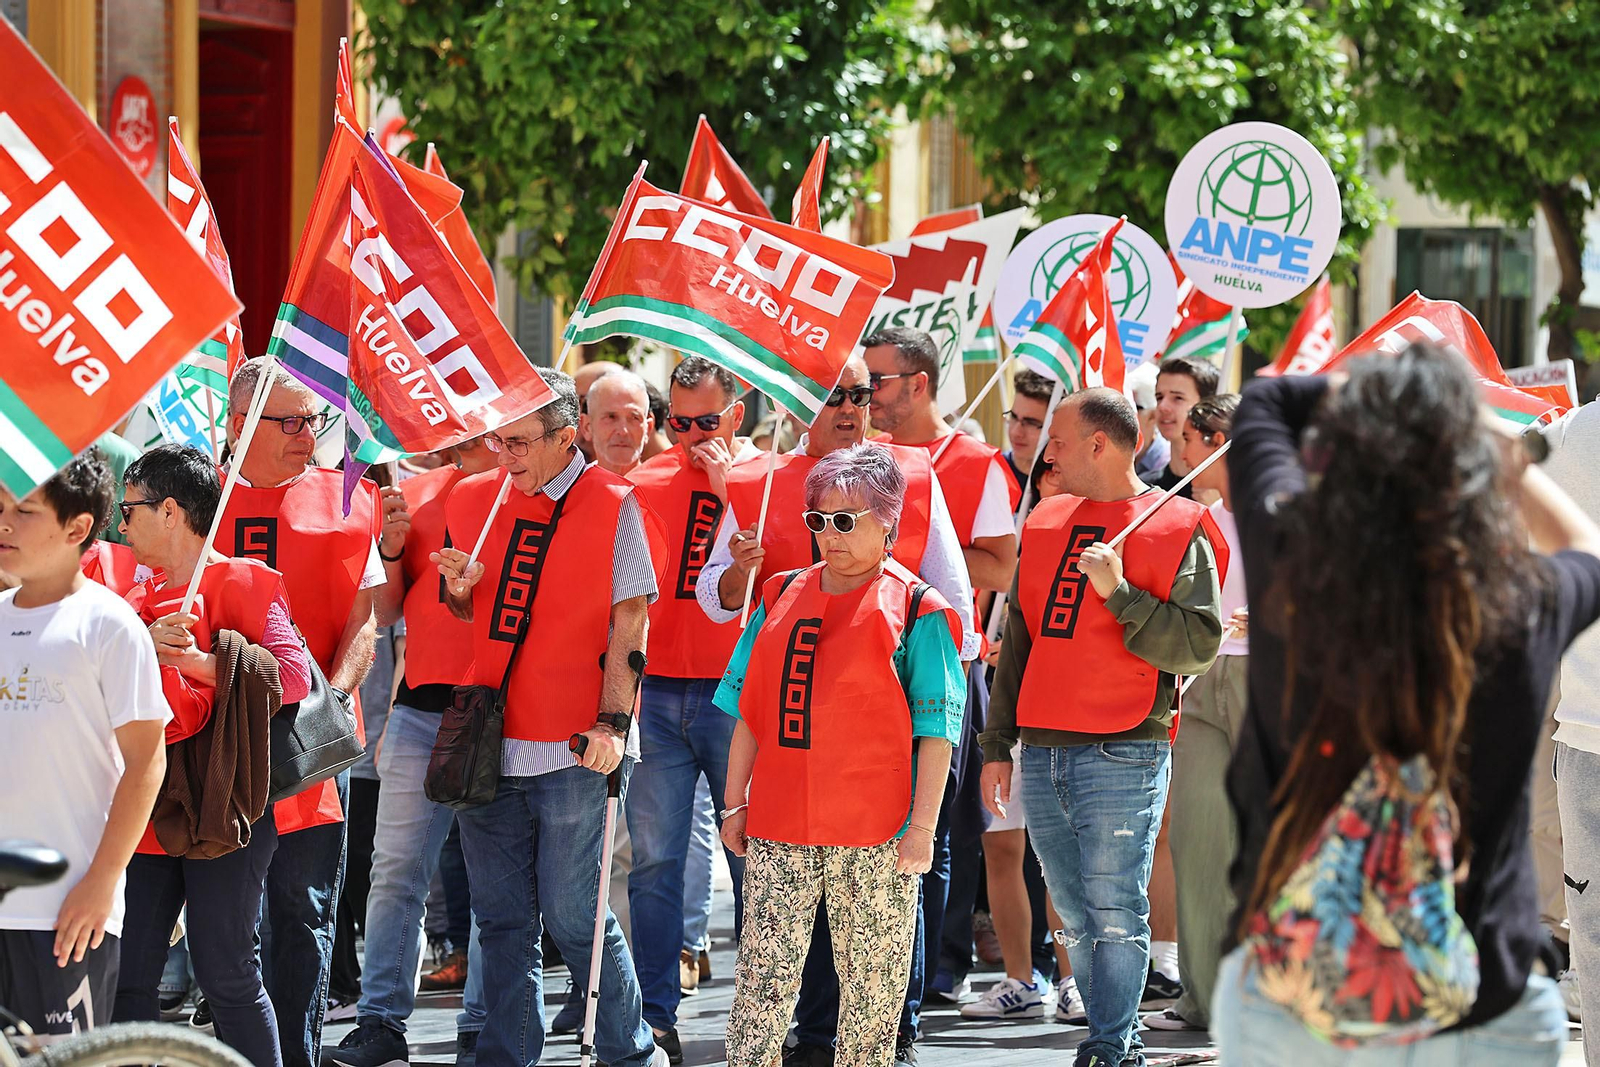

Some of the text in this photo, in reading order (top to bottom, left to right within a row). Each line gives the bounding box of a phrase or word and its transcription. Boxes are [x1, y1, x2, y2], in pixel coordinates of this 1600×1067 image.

[623, 195, 862, 318] CCOO
[1178, 251, 1307, 284] SINDICATO INDEPENDIENTE
[1180, 216, 1314, 275] ANPE
[1213, 273, 1263, 293] HUELVA
[709, 265, 831, 351] Huelva
[1009, 298, 1150, 357] AE
[356, 303, 448, 427] Huelva
[498, 528, 544, 634] CCOO
[784, 625, 820, 740] CCOO
